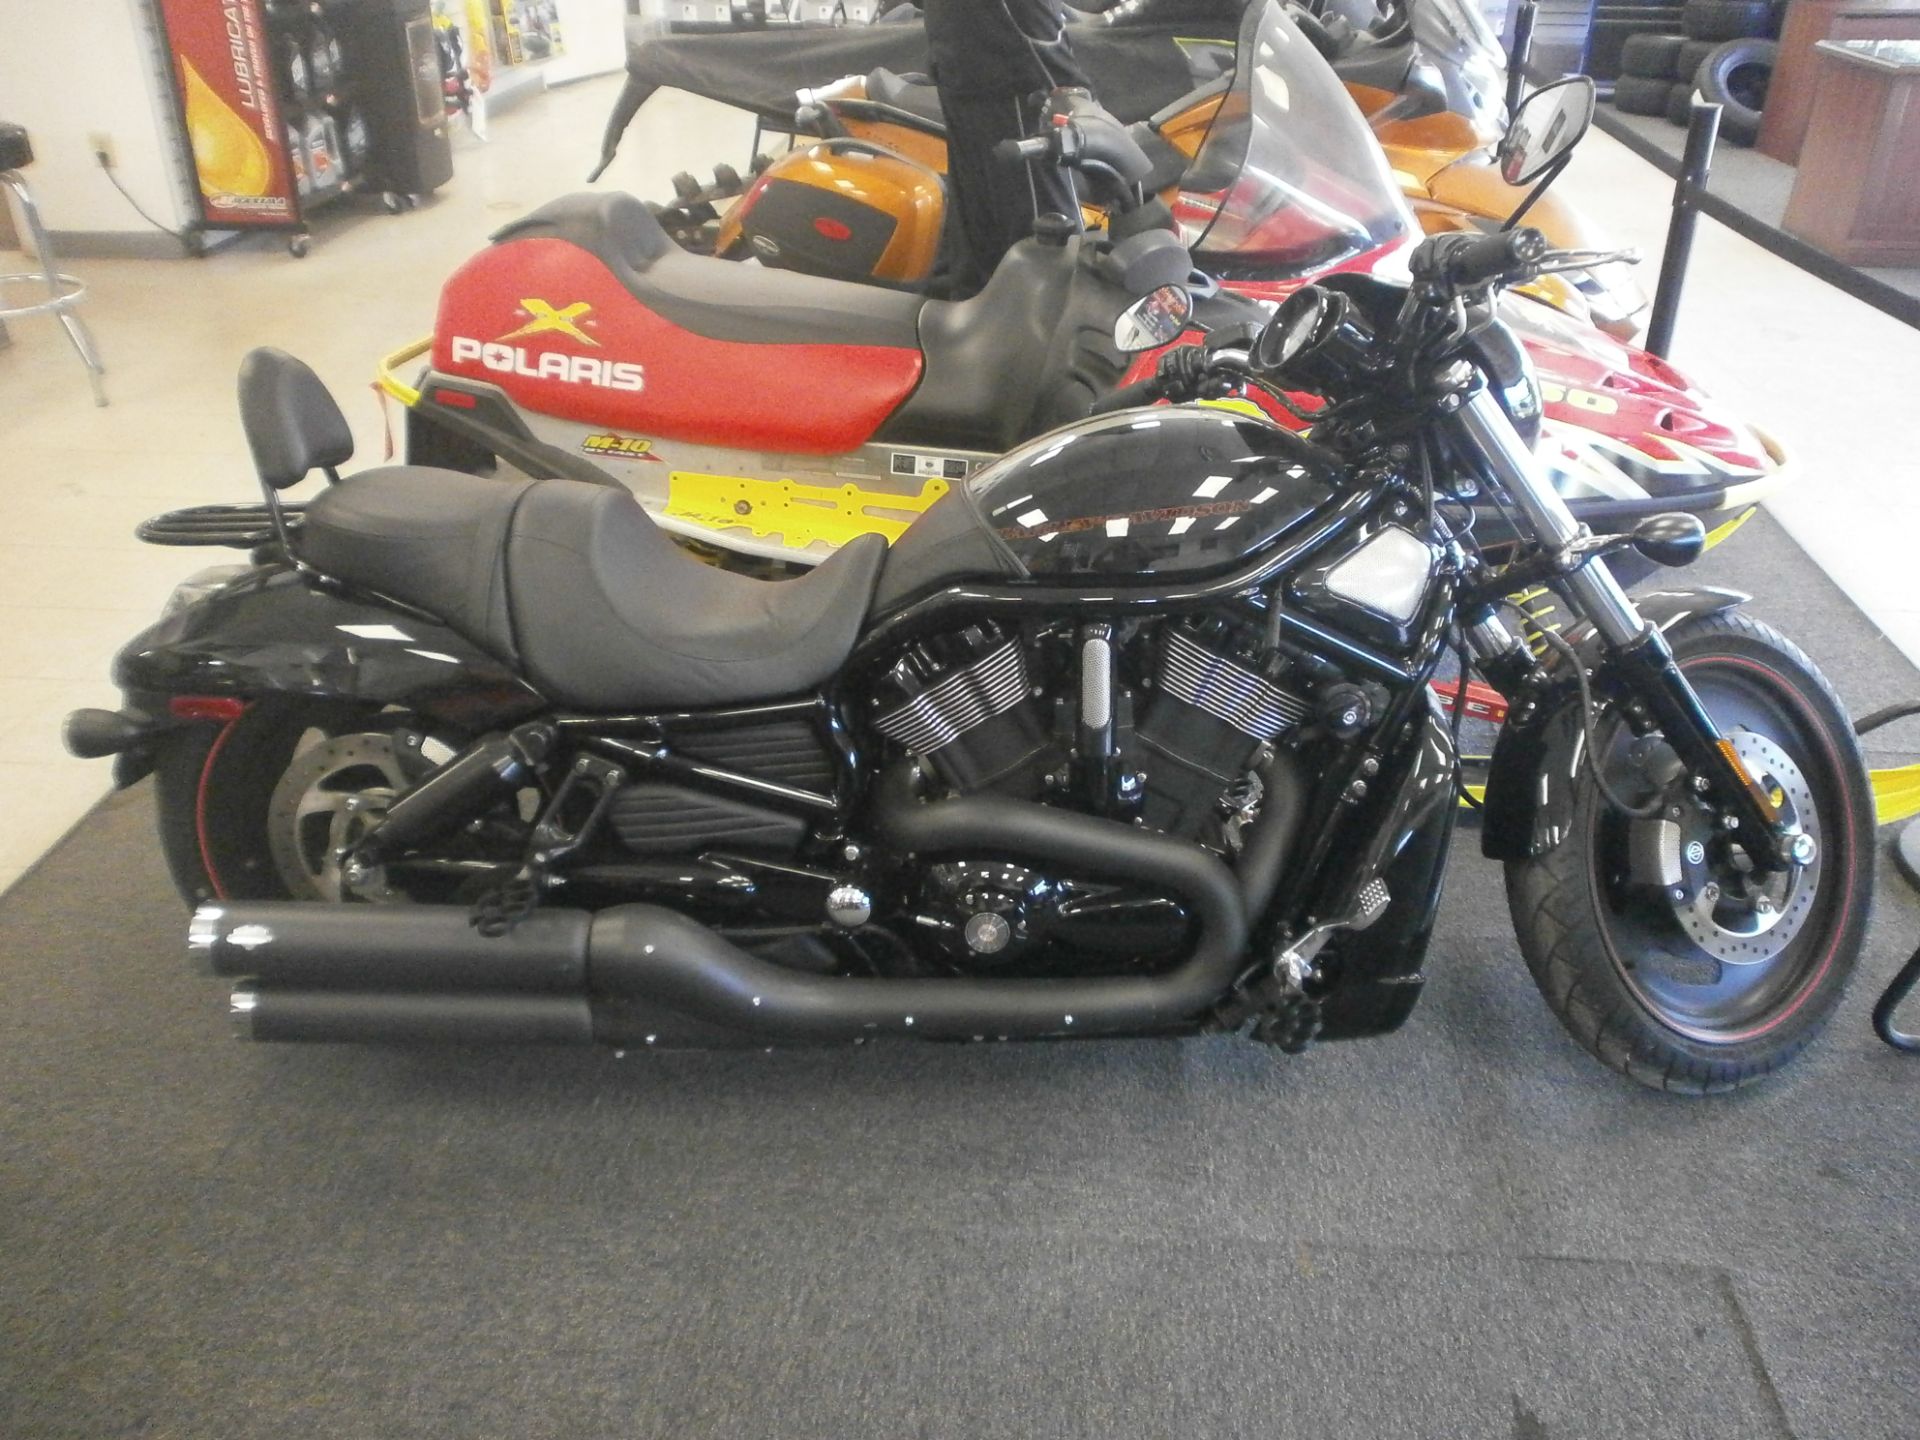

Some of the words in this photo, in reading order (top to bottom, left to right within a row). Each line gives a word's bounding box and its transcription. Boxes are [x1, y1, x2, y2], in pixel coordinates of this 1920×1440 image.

[222, 0, 255, 108] LUBRICA
[452, 335, 644, 391] POLARIS
[583, 435, 652, 453] M-10
